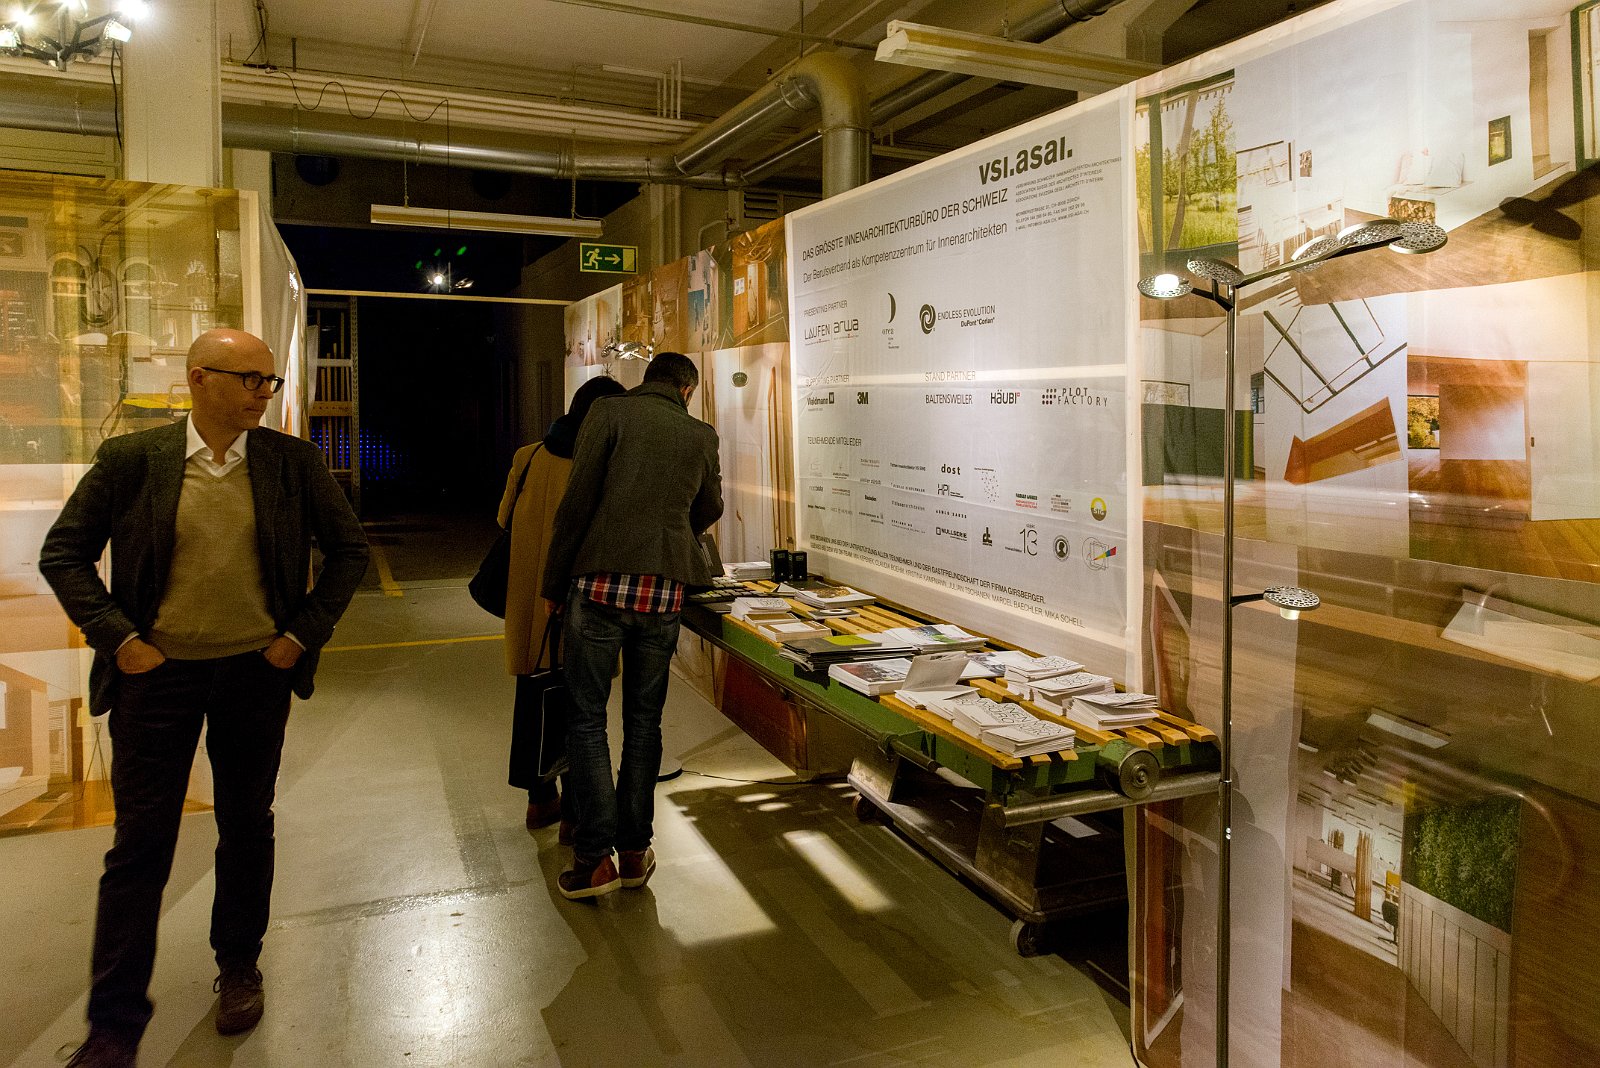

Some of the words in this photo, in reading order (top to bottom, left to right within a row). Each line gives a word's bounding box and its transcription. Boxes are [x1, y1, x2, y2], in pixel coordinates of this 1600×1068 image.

[802, 249, 814, 261] DAS
[815, 236, 843, 257] GRÖSSTE
[845, 208, 939, 246] INNENARCHITEKTURBÜRO
[941, 203, 960, 220] DER
[962, 188, 1008, 214] SCHWEIZ
[803, 272, 812, 283] Der
[812, 259, 851, 280] Berufsverband
[851, 257, 860, 269] als
[861, 243, 924, 266] Kompetenzzentrum
[926, 239, 936, 252] für
[938, 222, 1007, 249] Innenarchitekten
[803, 304, 828, 317] PRESENTING
[828, 300, 848, 312] PARTNER
[937, 309, 962, 321] ENDLESS
[963, 305, 996, 318] EVOLUTION
[804, 323, 831, 340] LAUFEN
[833, 318, 859, 334] arwa
[925, 371, 945, 382] STAND
[946, 370, 976, 381] PARTNER
[857, 391, 869, 405] 3M
[925, 394, 973, 405] BALTENSWEILER
[1062, 387, 1089, 397] PLOT
[1057, 396, 1108, 407] FACTORY
[836, 437, 862, 447] MITGLIEDER
[941, 463, 961, 475] dost
[922, 563, 932, 572] DER
[931, 566, 979, 586] GASTFREUNDSCHAFT
[979, 579, 991, 589] DER
[991, 582, 1008, 594] FIRMA
[1008, 587, 1046, 604] GIRSBERGER.
[949, 583, 965, 593] JULIAN
[991, 593, 1013, 607] MARCEL
[1044, 610, 1060, 621] MIKA
